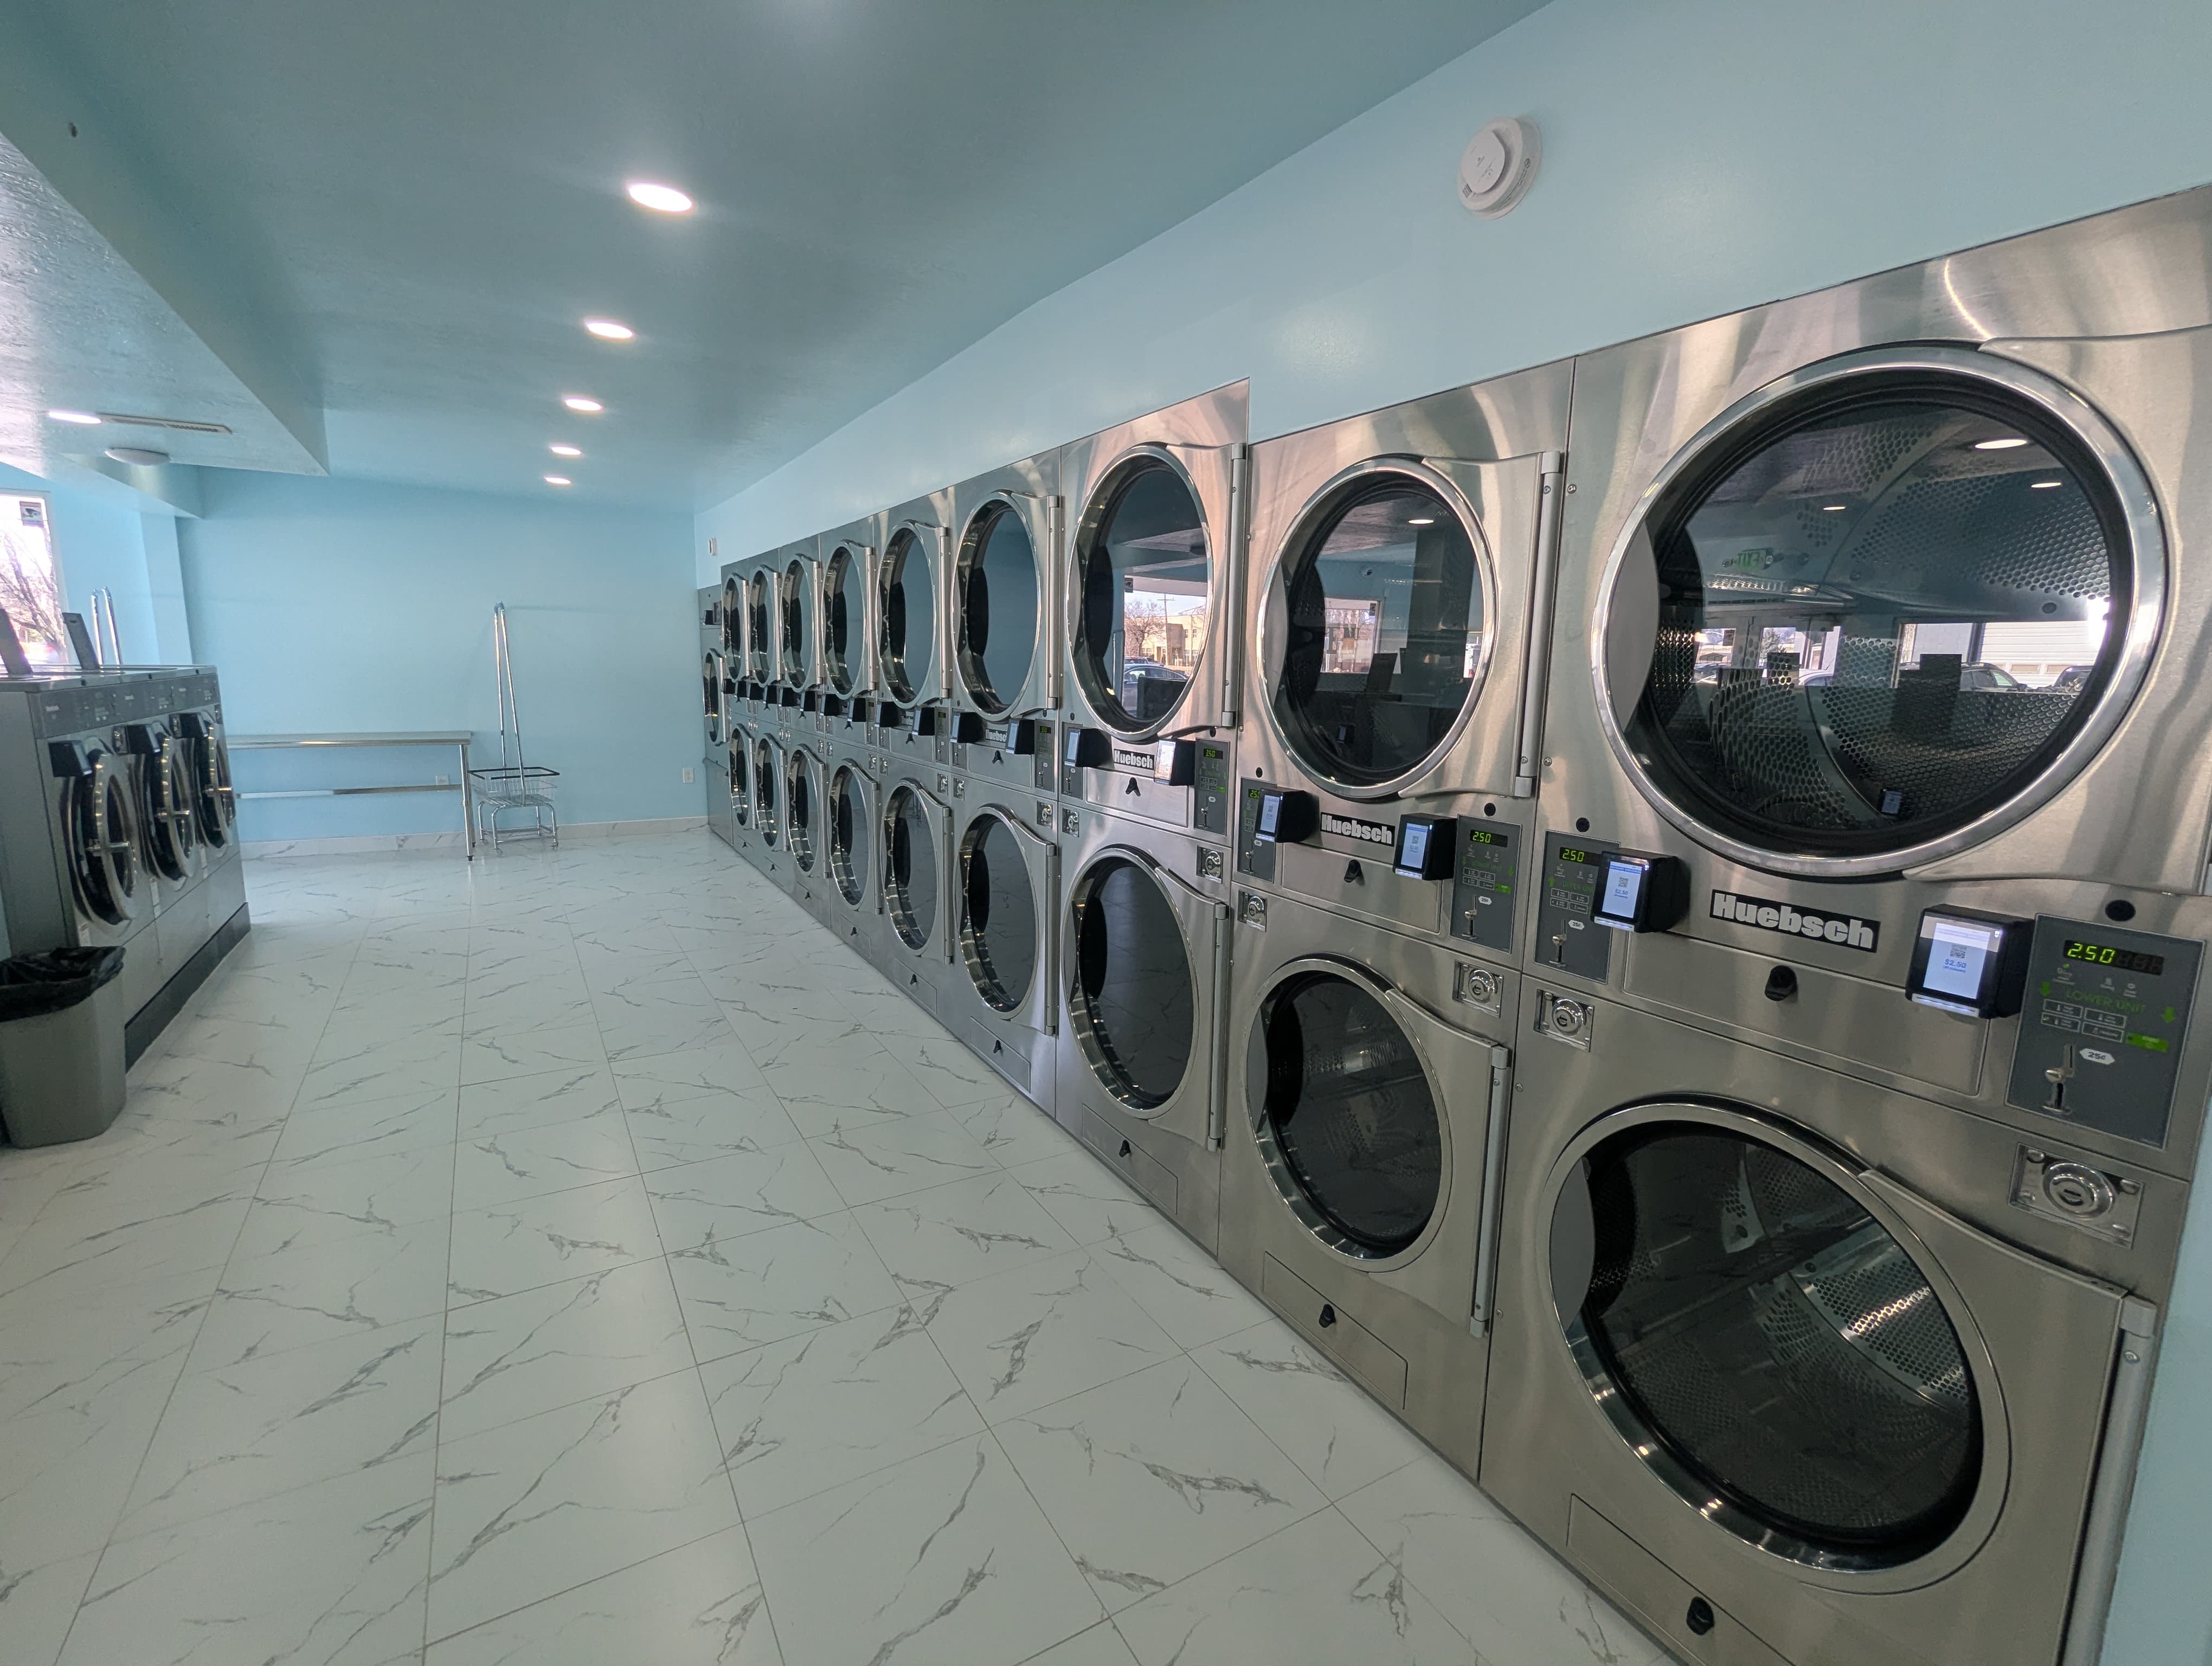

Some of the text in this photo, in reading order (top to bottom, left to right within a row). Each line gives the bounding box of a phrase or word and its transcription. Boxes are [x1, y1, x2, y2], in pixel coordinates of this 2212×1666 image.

[986, 729, 1007, 742] Huebsc
[1114, 750, 1153, 768] Huebsch
[1321, 814, 1392, 844] Huebsch
[1472, 831, 1491, 843] 2.50
[1562, 849, 1584, 862] 2.50
[1713, 893, 1874, 949] Huebsch
[2067, 943, 2116, 964] 2.50
[1944, 958, 1966, 968] $2.50
[2066, 989, 2112, 1007] LOWER
[2116, 1000, 2146, 1014] UNIT
